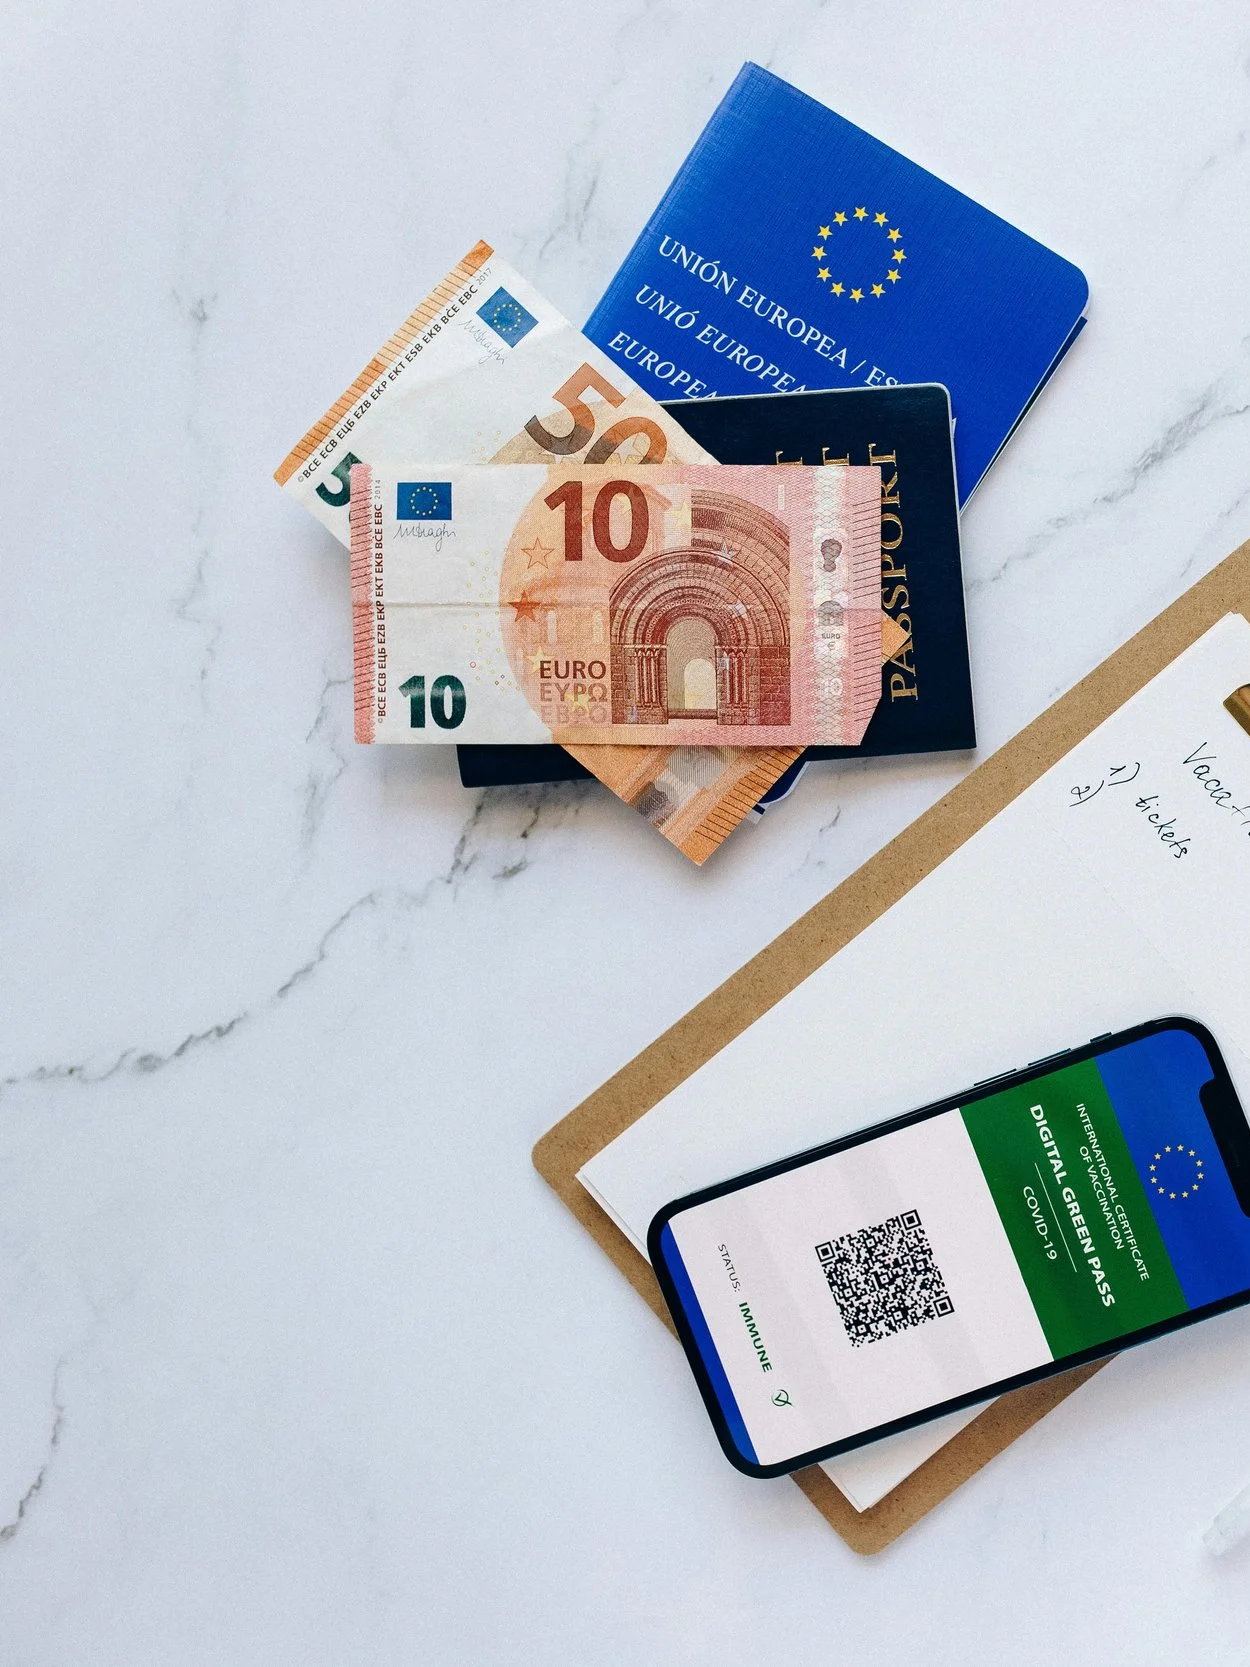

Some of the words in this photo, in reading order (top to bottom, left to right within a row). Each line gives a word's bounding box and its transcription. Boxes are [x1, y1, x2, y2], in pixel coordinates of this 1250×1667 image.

[635, 284, 697, 330] UNIÓ
[659, 234, 737, 296] UNIÓN
[736, 288, 848, 370] EUROPEA
[320, 439, 338, 460] ECB
[354, 399, 372, 420] EZB
[405, 344, 423, 363] ESB
[422, 324, 442, 344] EKB
[458, 284, 479, 306] EBC
[476, 267, 493, 286] 2017
[374, 504, 383, 525] EBC
[544, 480, 649, 562] 10
[375, 552, 384, 573] EKB
[377, 624, 386, 644] EZB
[540, 660, 607, 679] EURO
[398, 674, 466, 729] 10
[1108, 762, 1140, 787] 1)
[1135, 795, 1191, 858] tickets
[1023, 1186, 1057, 1260] COVID-19
[1030, 1104, 1063, 1185] DIGITAL
[1062, 1187, 1096, 1254] GREEN
[1087, 1257, 1116, 1307] PASS
[1076, 1103, 1115, 1204] INTERNATIONAL
[1115, 1204, 1150, 1281] CERTIFICATE
[1079, 1145, 1091, 1163] OF
[1085, 1162, 1125, 1250] VACCINATION
[718, 1244, 741, 1292] STATUS:
[738, 1302, 772, 1373] IMMUNE
